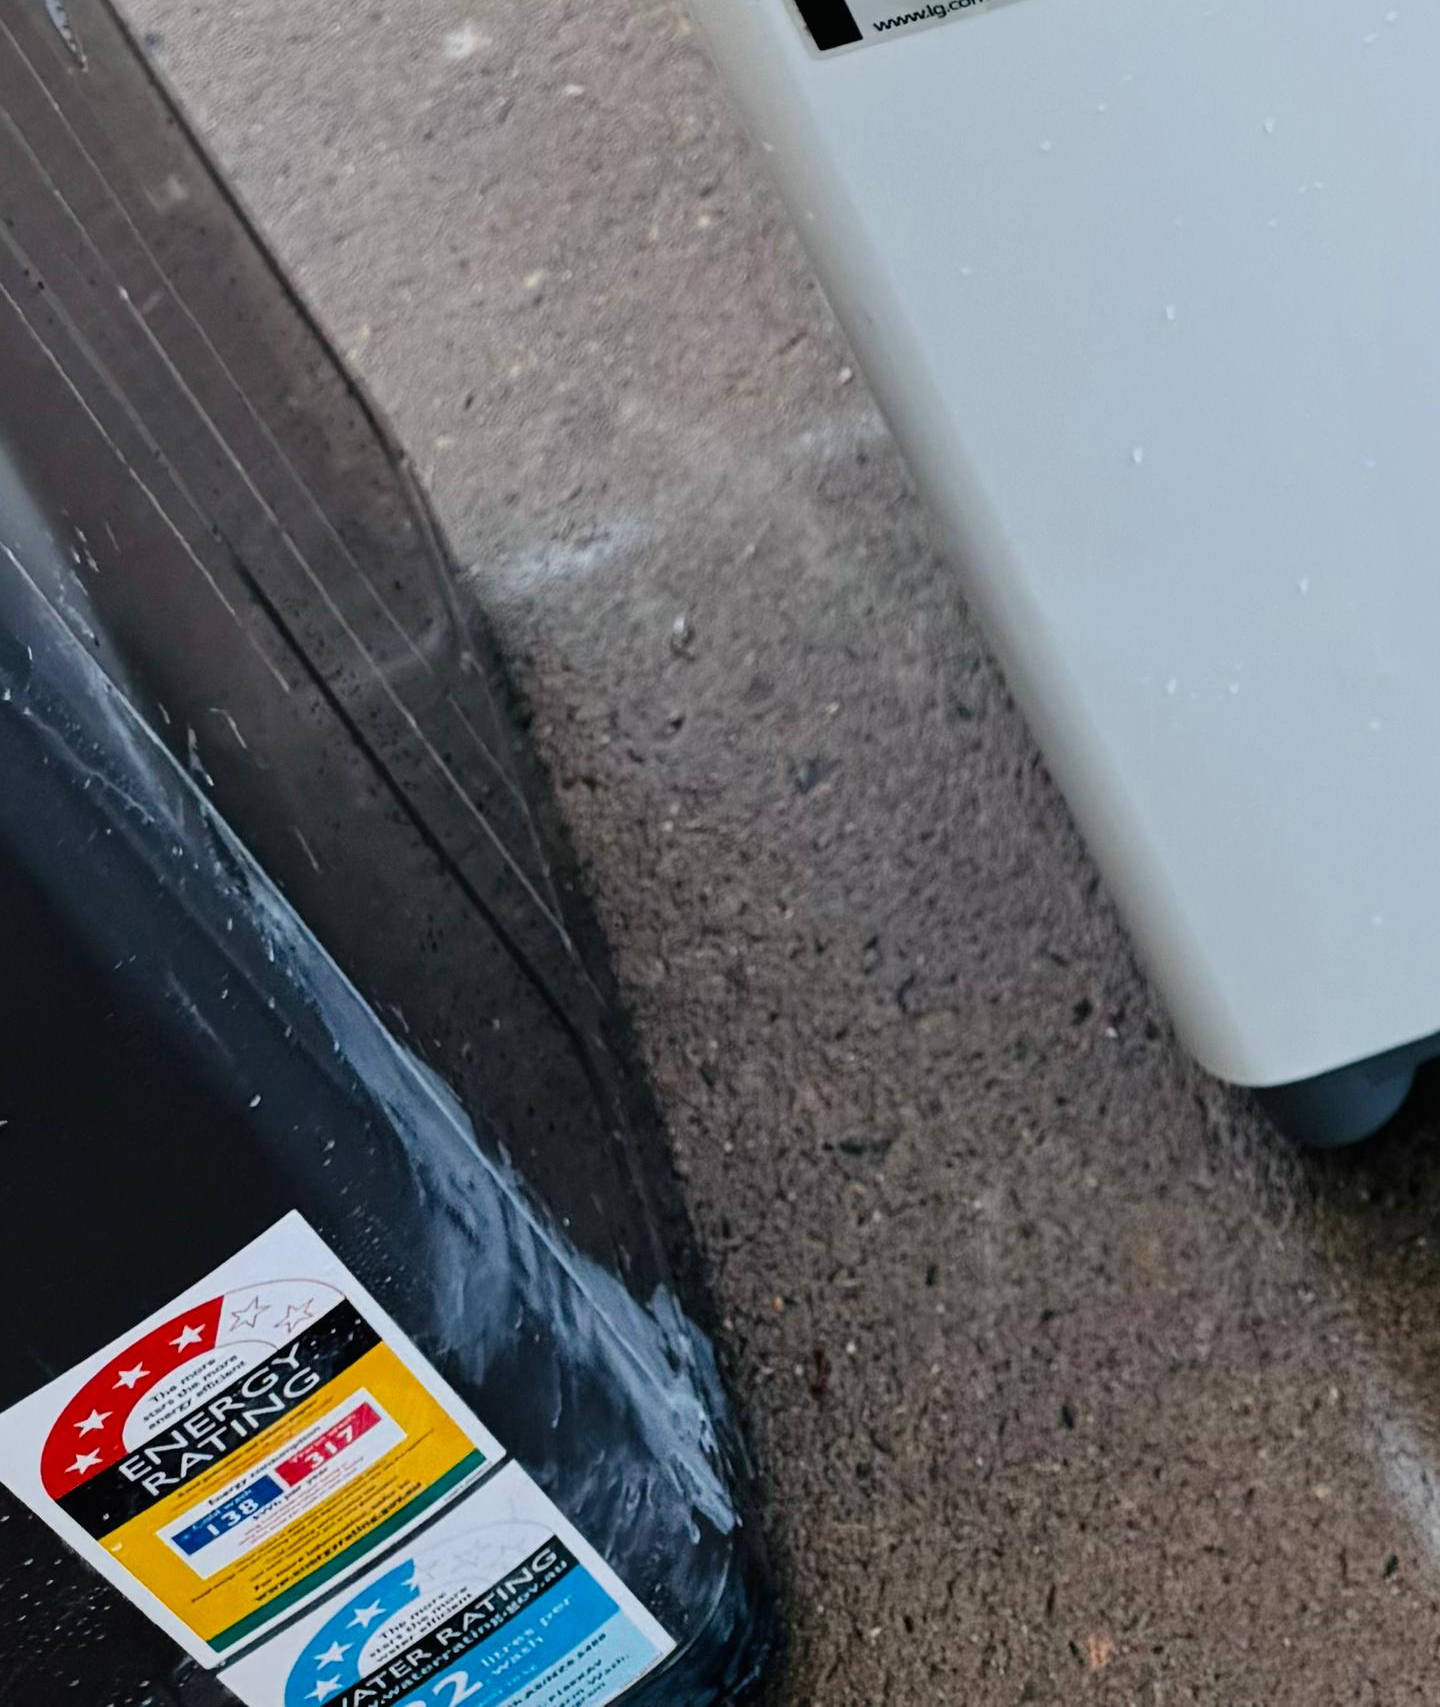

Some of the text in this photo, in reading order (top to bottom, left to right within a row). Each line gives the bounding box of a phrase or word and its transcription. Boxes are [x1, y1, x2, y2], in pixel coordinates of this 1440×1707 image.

[118, 1342, 301, 1483] ENERGY
[141, 1366, 320, 1497] RATING
[304, 1425, 354, 1469] 317
[206, 1498, 260, 1537] 138
[435, 1547, 558, 1646] RATING
